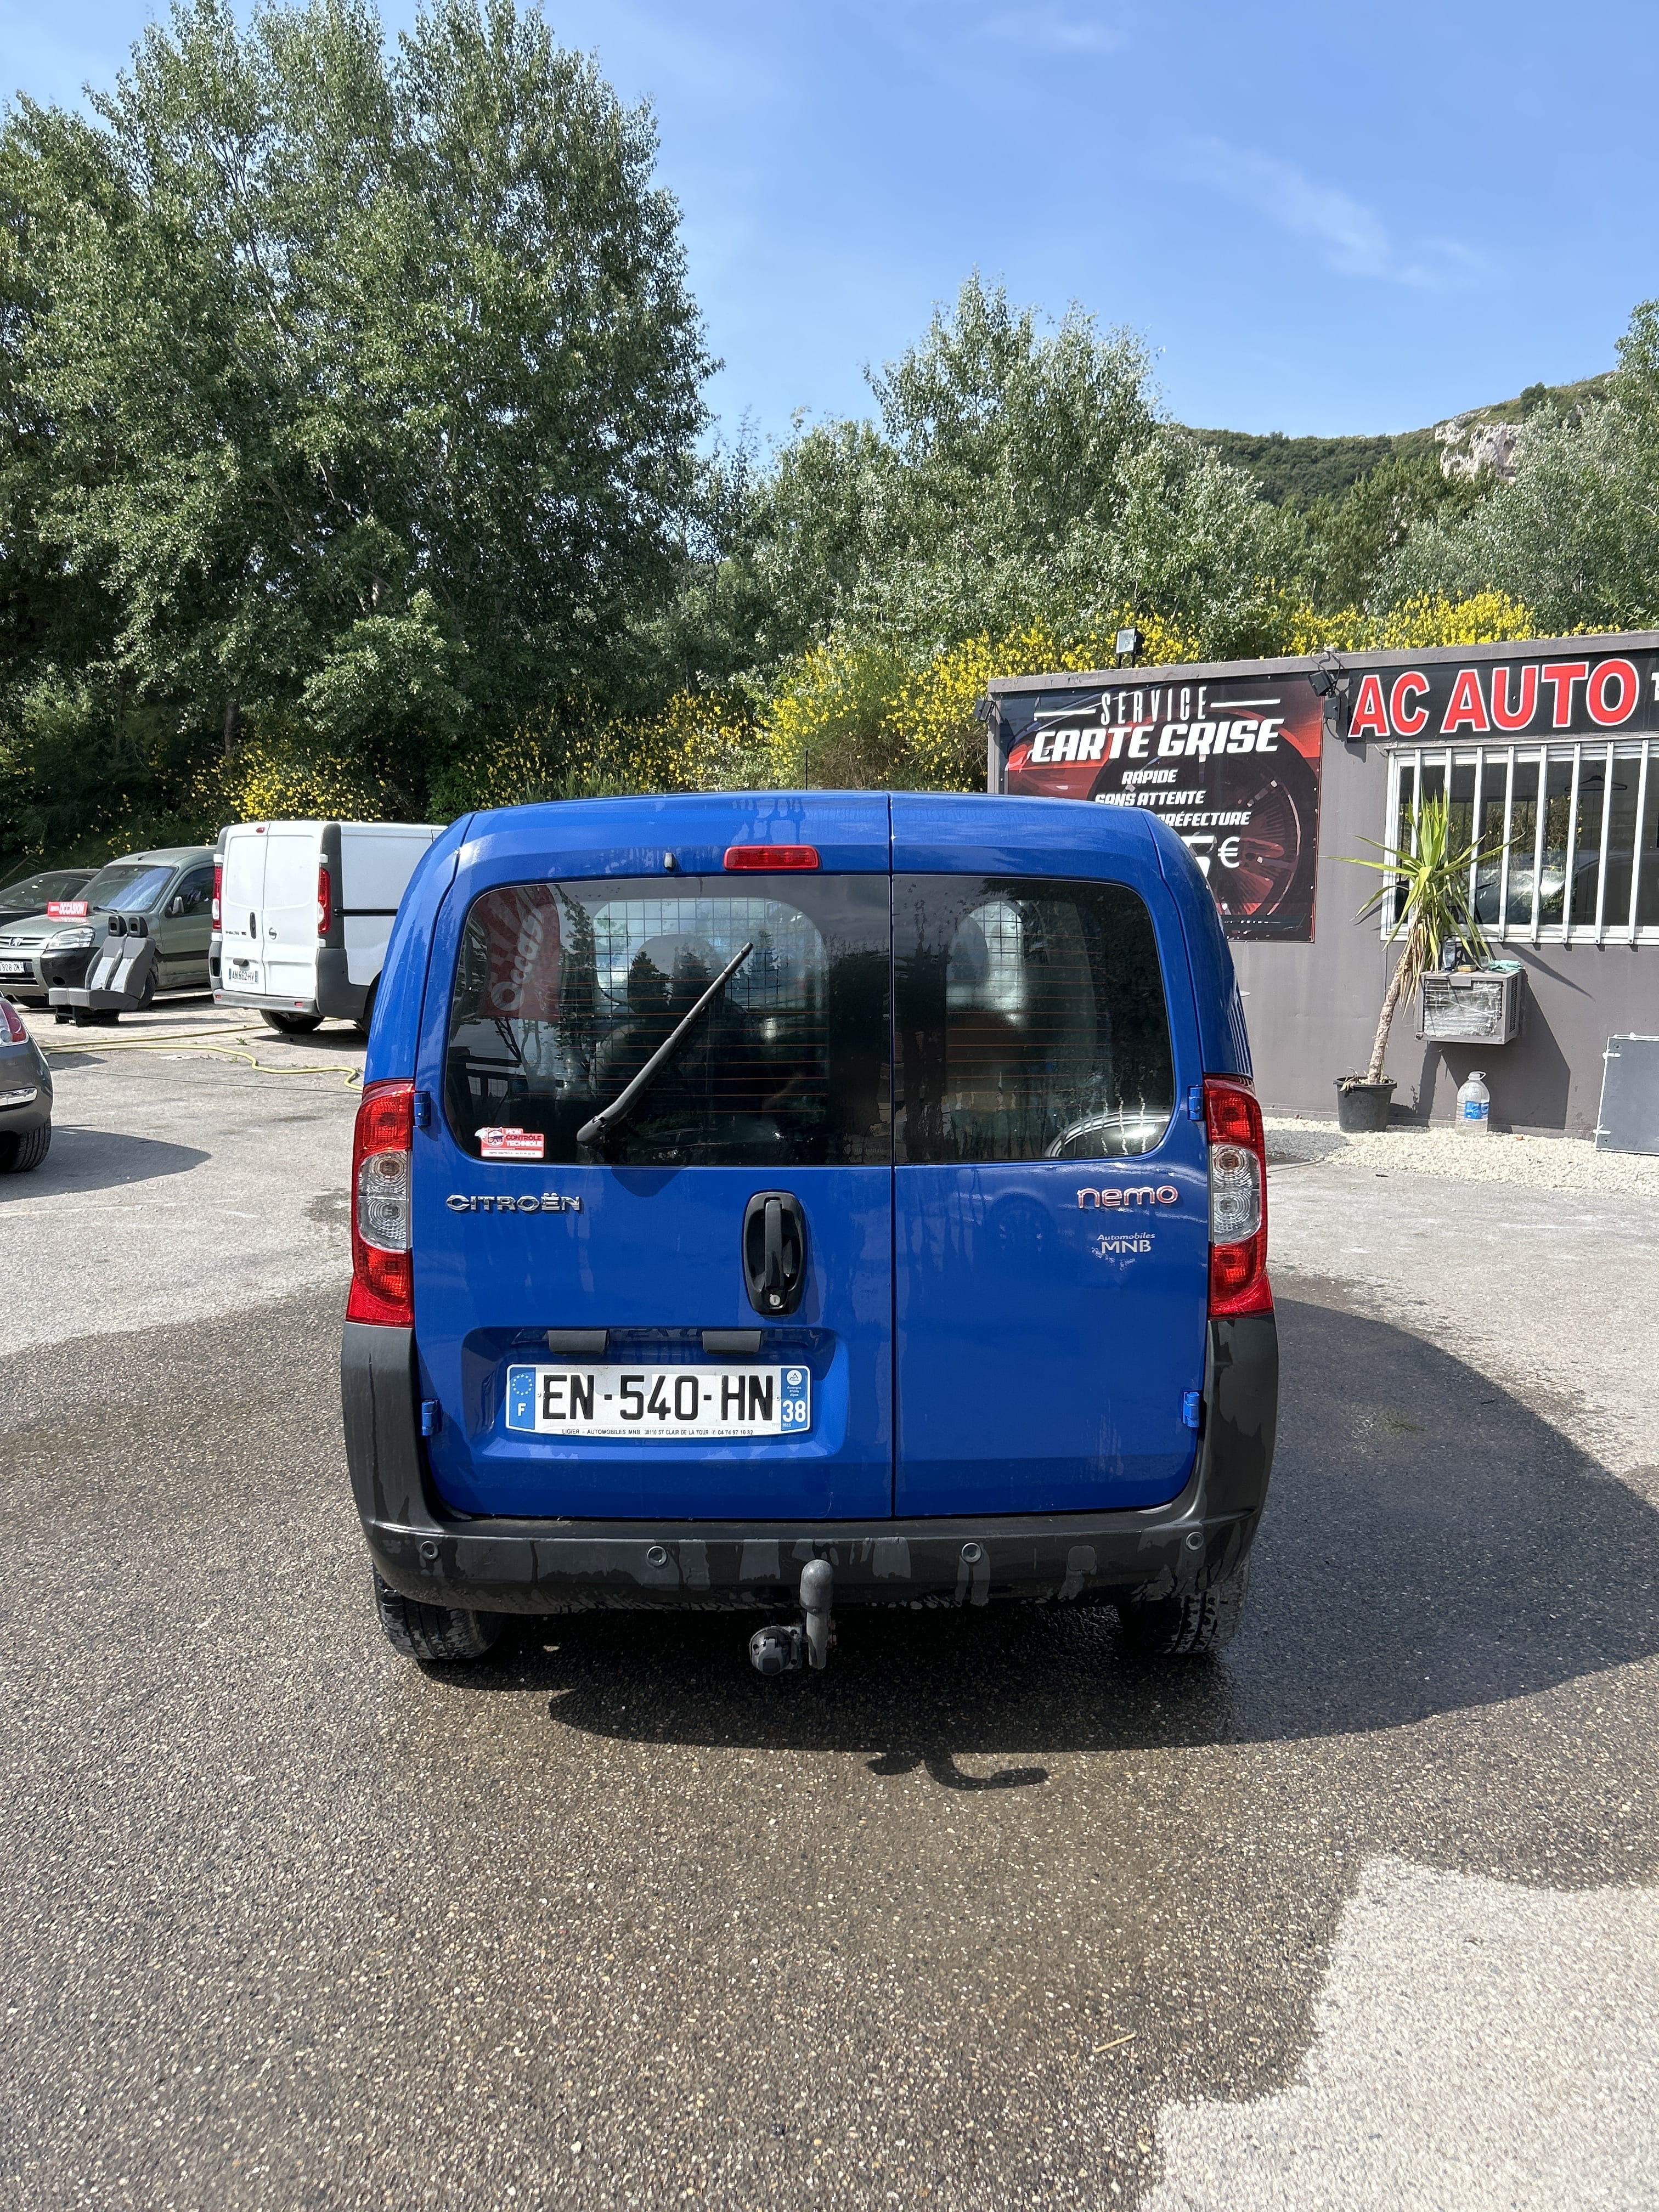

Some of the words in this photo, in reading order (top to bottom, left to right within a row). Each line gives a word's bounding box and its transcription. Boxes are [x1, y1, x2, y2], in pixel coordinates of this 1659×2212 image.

[1101, 686, 1207, 726] SERVICE
[1347, 670, 1431, 738] AC
[1440, 658, 1640, 735] AUTO
[1030, 724, 1154, 763] CARTE
[1157, 718, 1285, 758] GRISE
[1121, 769, 1178, 785] RAPIDE
[1095, 793, 1136, 806] SANS
[1137, 790, 1207, 806] ATTENTE
[59, 902, 85, 915] OCCASION
[445, 1193, 582, 1212] CITROËN
[1076, 1185, 1178, 1209] nemo
[1097, 1232, 1156, 1241] Automobiles
[1101, 1240, 1152, 1254] MNB
[518, 1403, 526, 1417] F
[782, 1400, 806, 1423] 38
